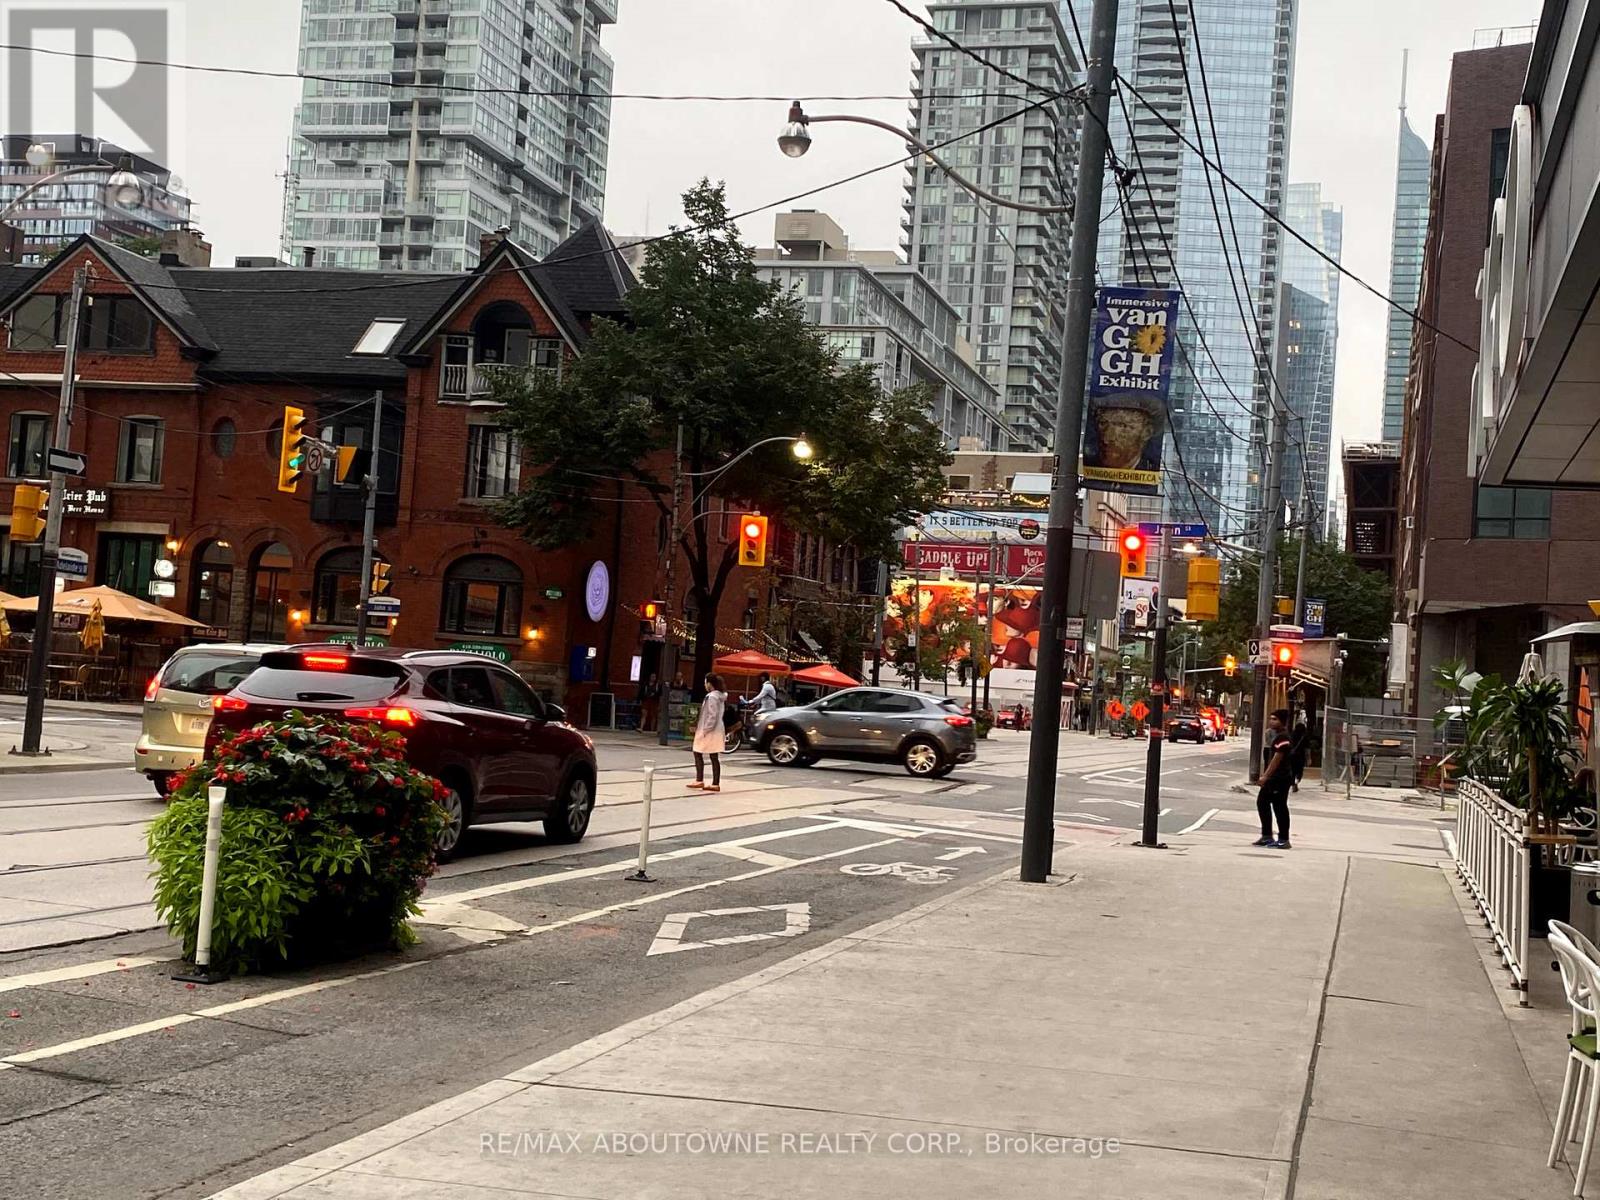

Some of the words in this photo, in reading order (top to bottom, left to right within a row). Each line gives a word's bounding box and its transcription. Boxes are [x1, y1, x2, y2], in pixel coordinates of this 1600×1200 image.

[1105, 296, 1170, 308] Immersive
[1106, 307, 1168, 326] van
[1100, 350, 1163, 376] GH
[1098, 374, 1160, 391] Exhibit
[1083, 466, 1157, 483] VANGOGHEXHIBIT.CA
[86, 489, 107, 504] Pub
[929, 516, 948, 526] ITS
[949, 516, 983, 527] BETTER
[1154, 525, 1181, 536] Jon
[966, 551, 988, 567] UP!
